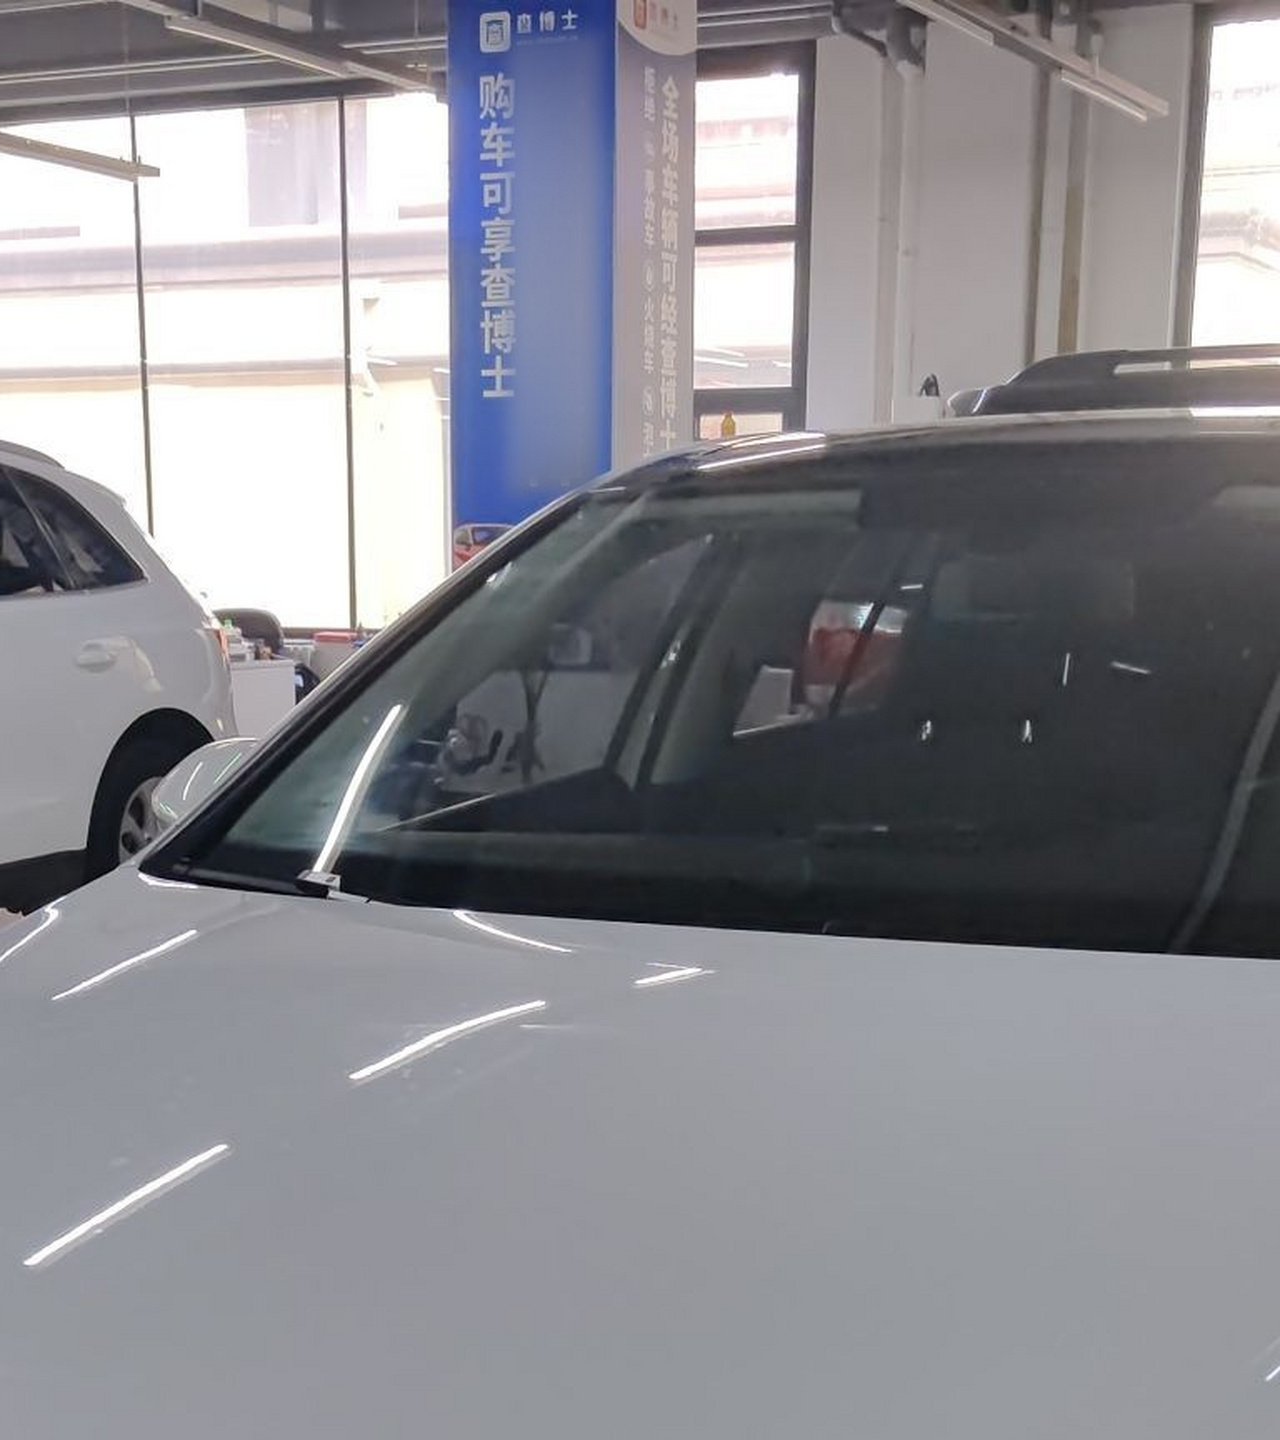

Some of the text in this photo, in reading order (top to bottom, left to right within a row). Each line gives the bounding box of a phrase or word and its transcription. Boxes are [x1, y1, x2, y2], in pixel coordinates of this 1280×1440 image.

[479, 72, 517, 399] 购车可享查博士
